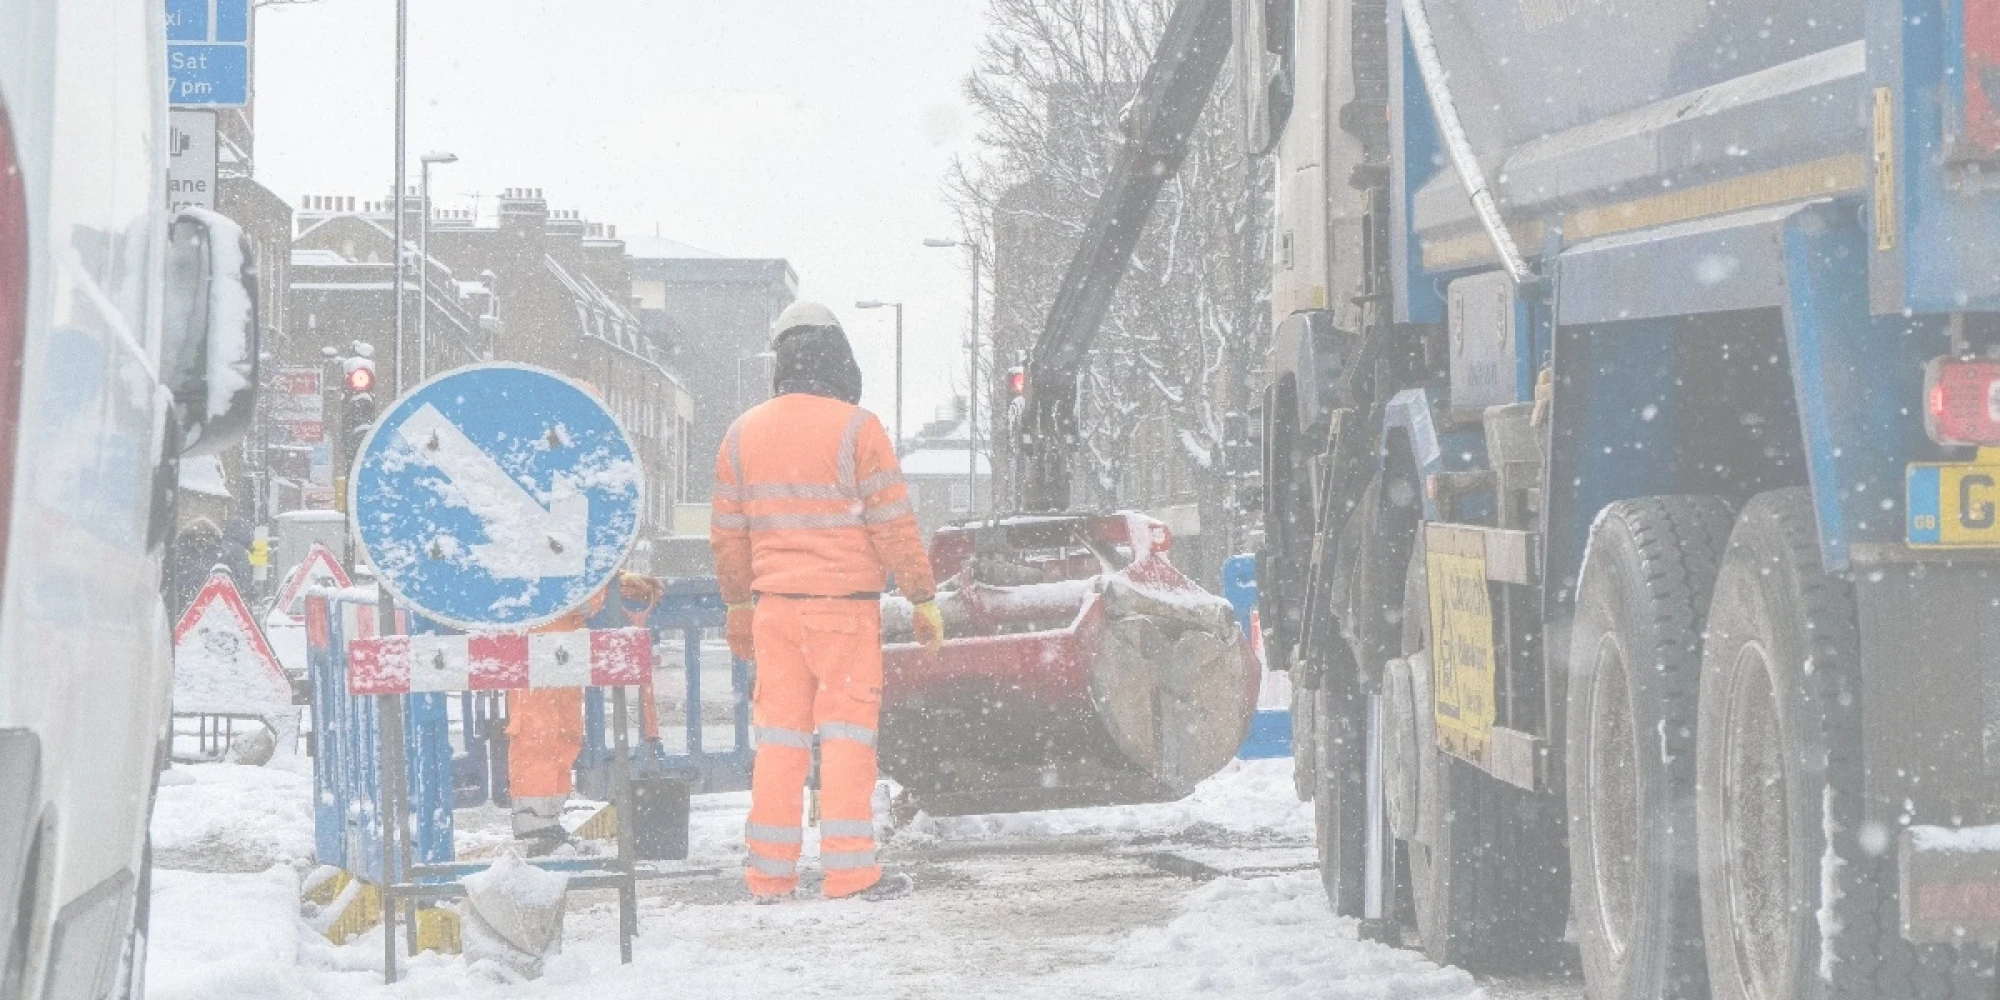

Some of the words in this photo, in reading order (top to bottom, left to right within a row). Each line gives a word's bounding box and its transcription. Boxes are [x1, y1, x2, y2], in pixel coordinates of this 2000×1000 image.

[172, 52, 207, 69] Sat
[1960, 474, 1995, 529] G
[1914, 514, 1936, 530] GB
